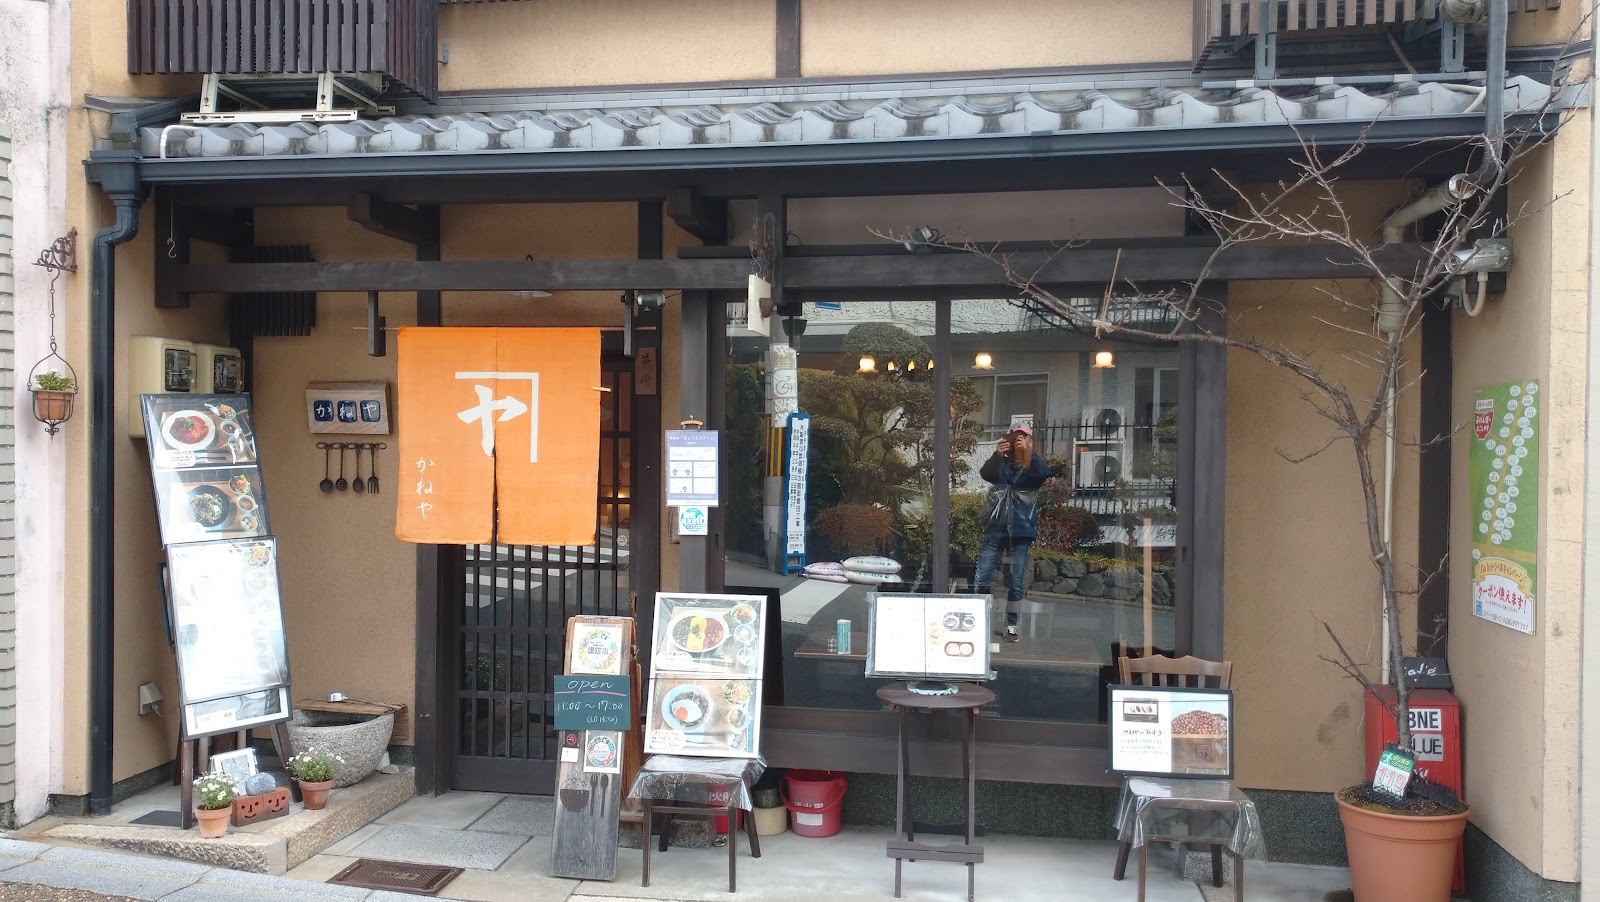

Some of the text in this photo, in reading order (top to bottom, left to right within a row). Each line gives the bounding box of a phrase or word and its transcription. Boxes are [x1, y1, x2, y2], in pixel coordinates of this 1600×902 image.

[315, 402, 377, 420] かねや
[415, 457, 435, 520] かねや
[567, 680, 614, 694] open
[1377, 767, 1406, 791] 119
